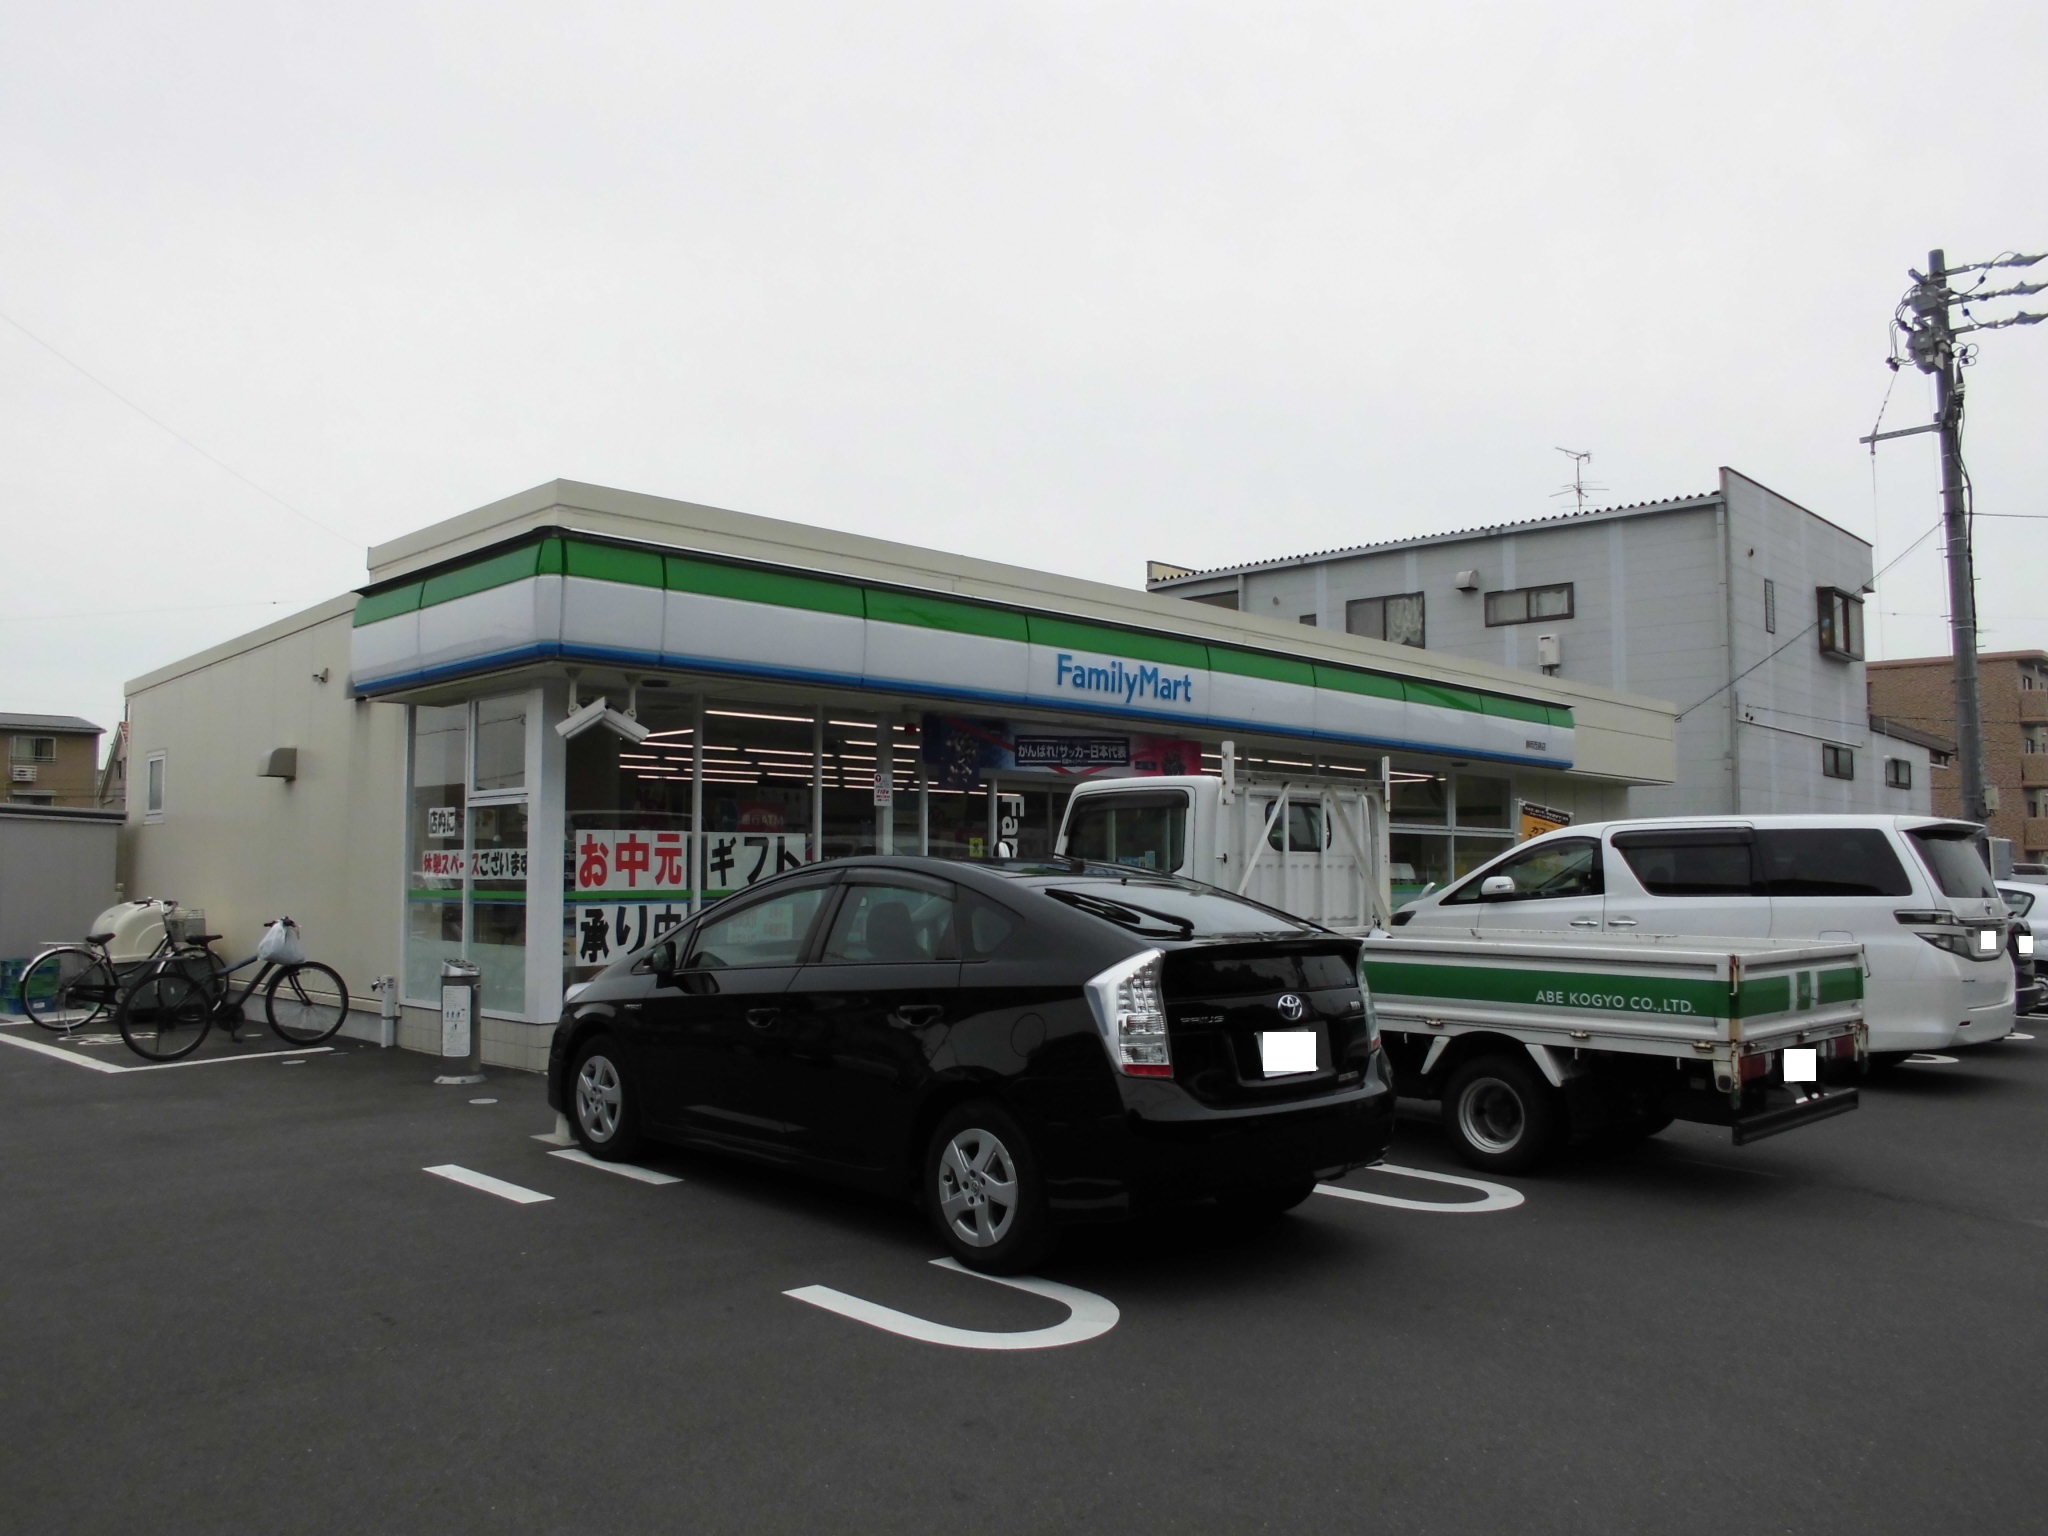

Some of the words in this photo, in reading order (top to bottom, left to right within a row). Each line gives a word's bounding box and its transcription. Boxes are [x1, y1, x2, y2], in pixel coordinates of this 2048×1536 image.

[1057, 653, 1192, 703] FamilyMart
[430, 810, 455, 834] 店内に
[579, 833, 683, 888] お中元
[710, 836, 801, 887] ギフト
[1535, 990, 1565, 1004] ABE
[1569, 992, 1625, 1008] KOGYO
